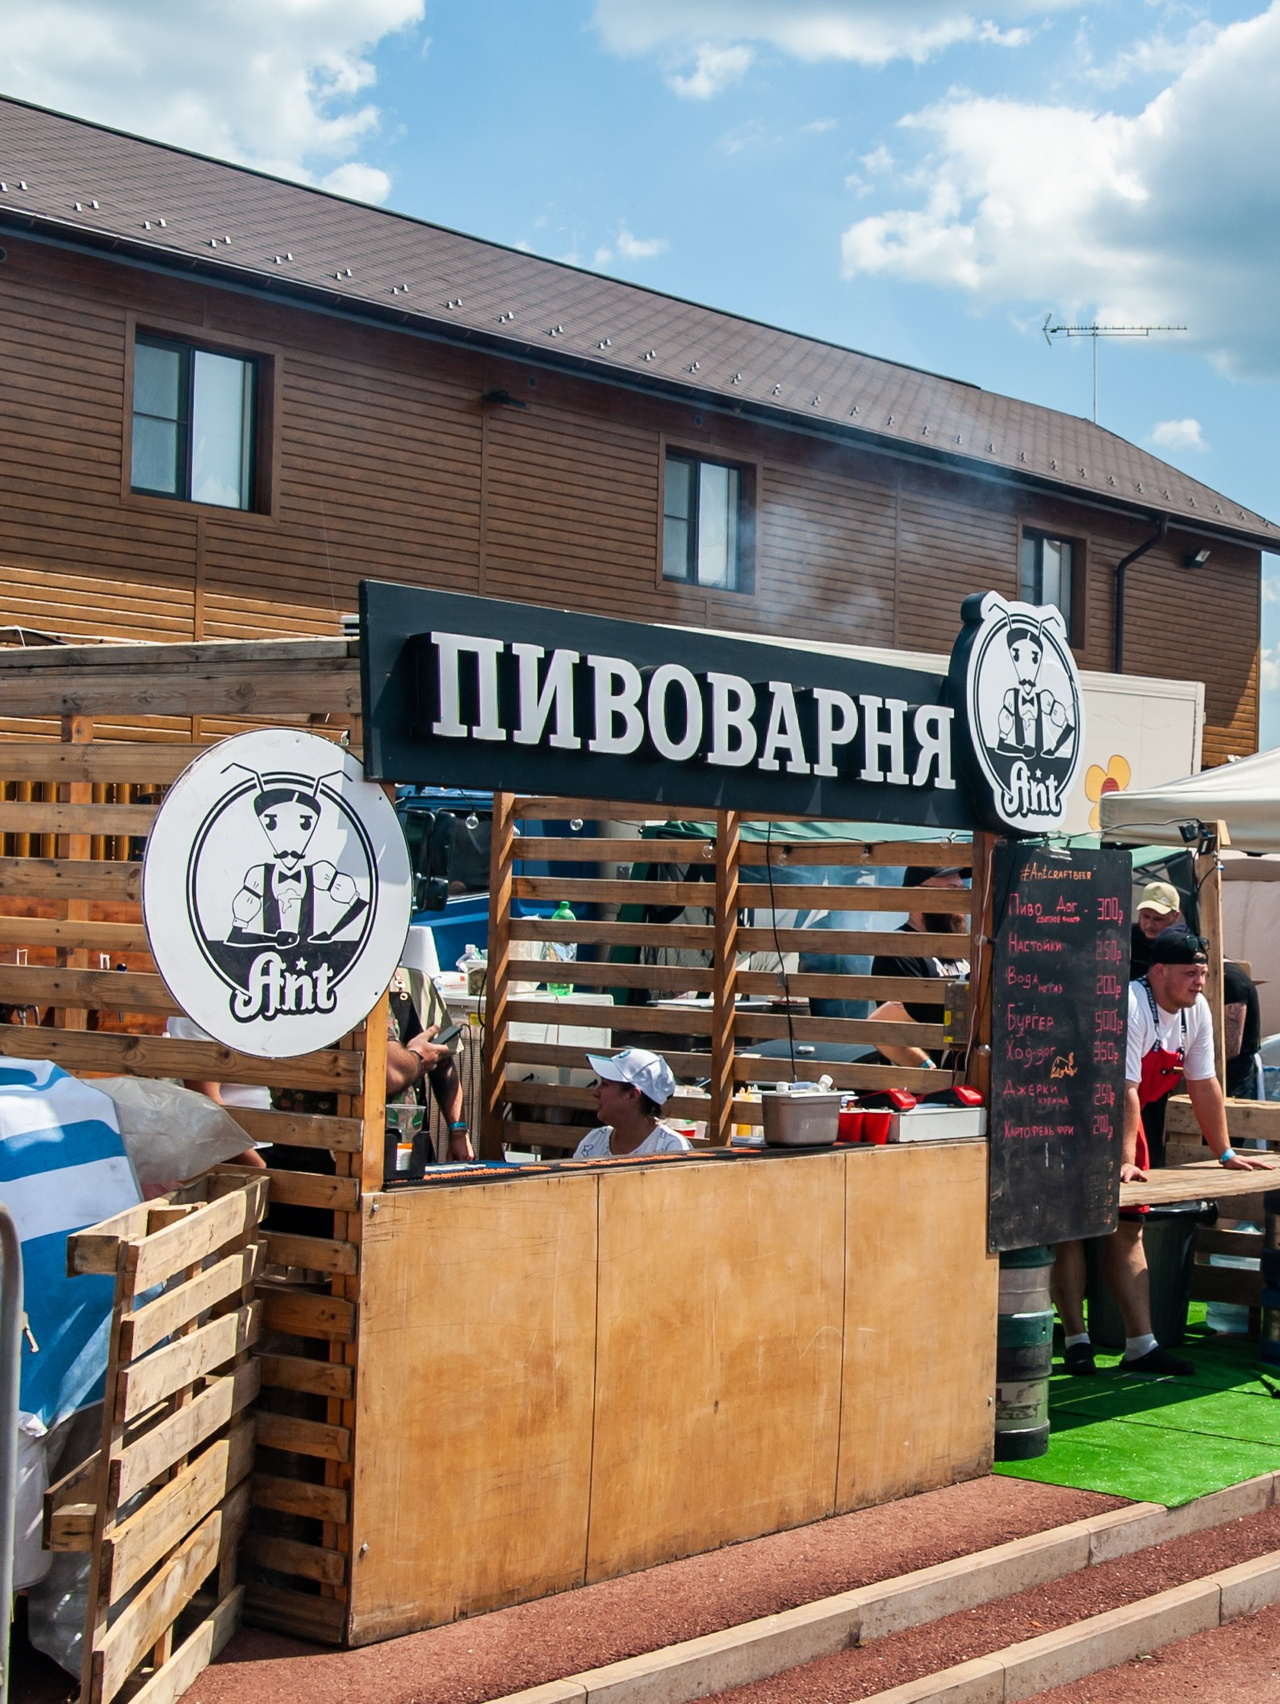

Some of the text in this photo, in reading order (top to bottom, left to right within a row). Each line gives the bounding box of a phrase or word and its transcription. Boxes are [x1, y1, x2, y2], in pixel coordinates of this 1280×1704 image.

[430, 631, 956, 790] ПИВОВАРНЯ
[1002, 760, 1062, 818] Ant
[228, 950, 338, 1024] Ant
